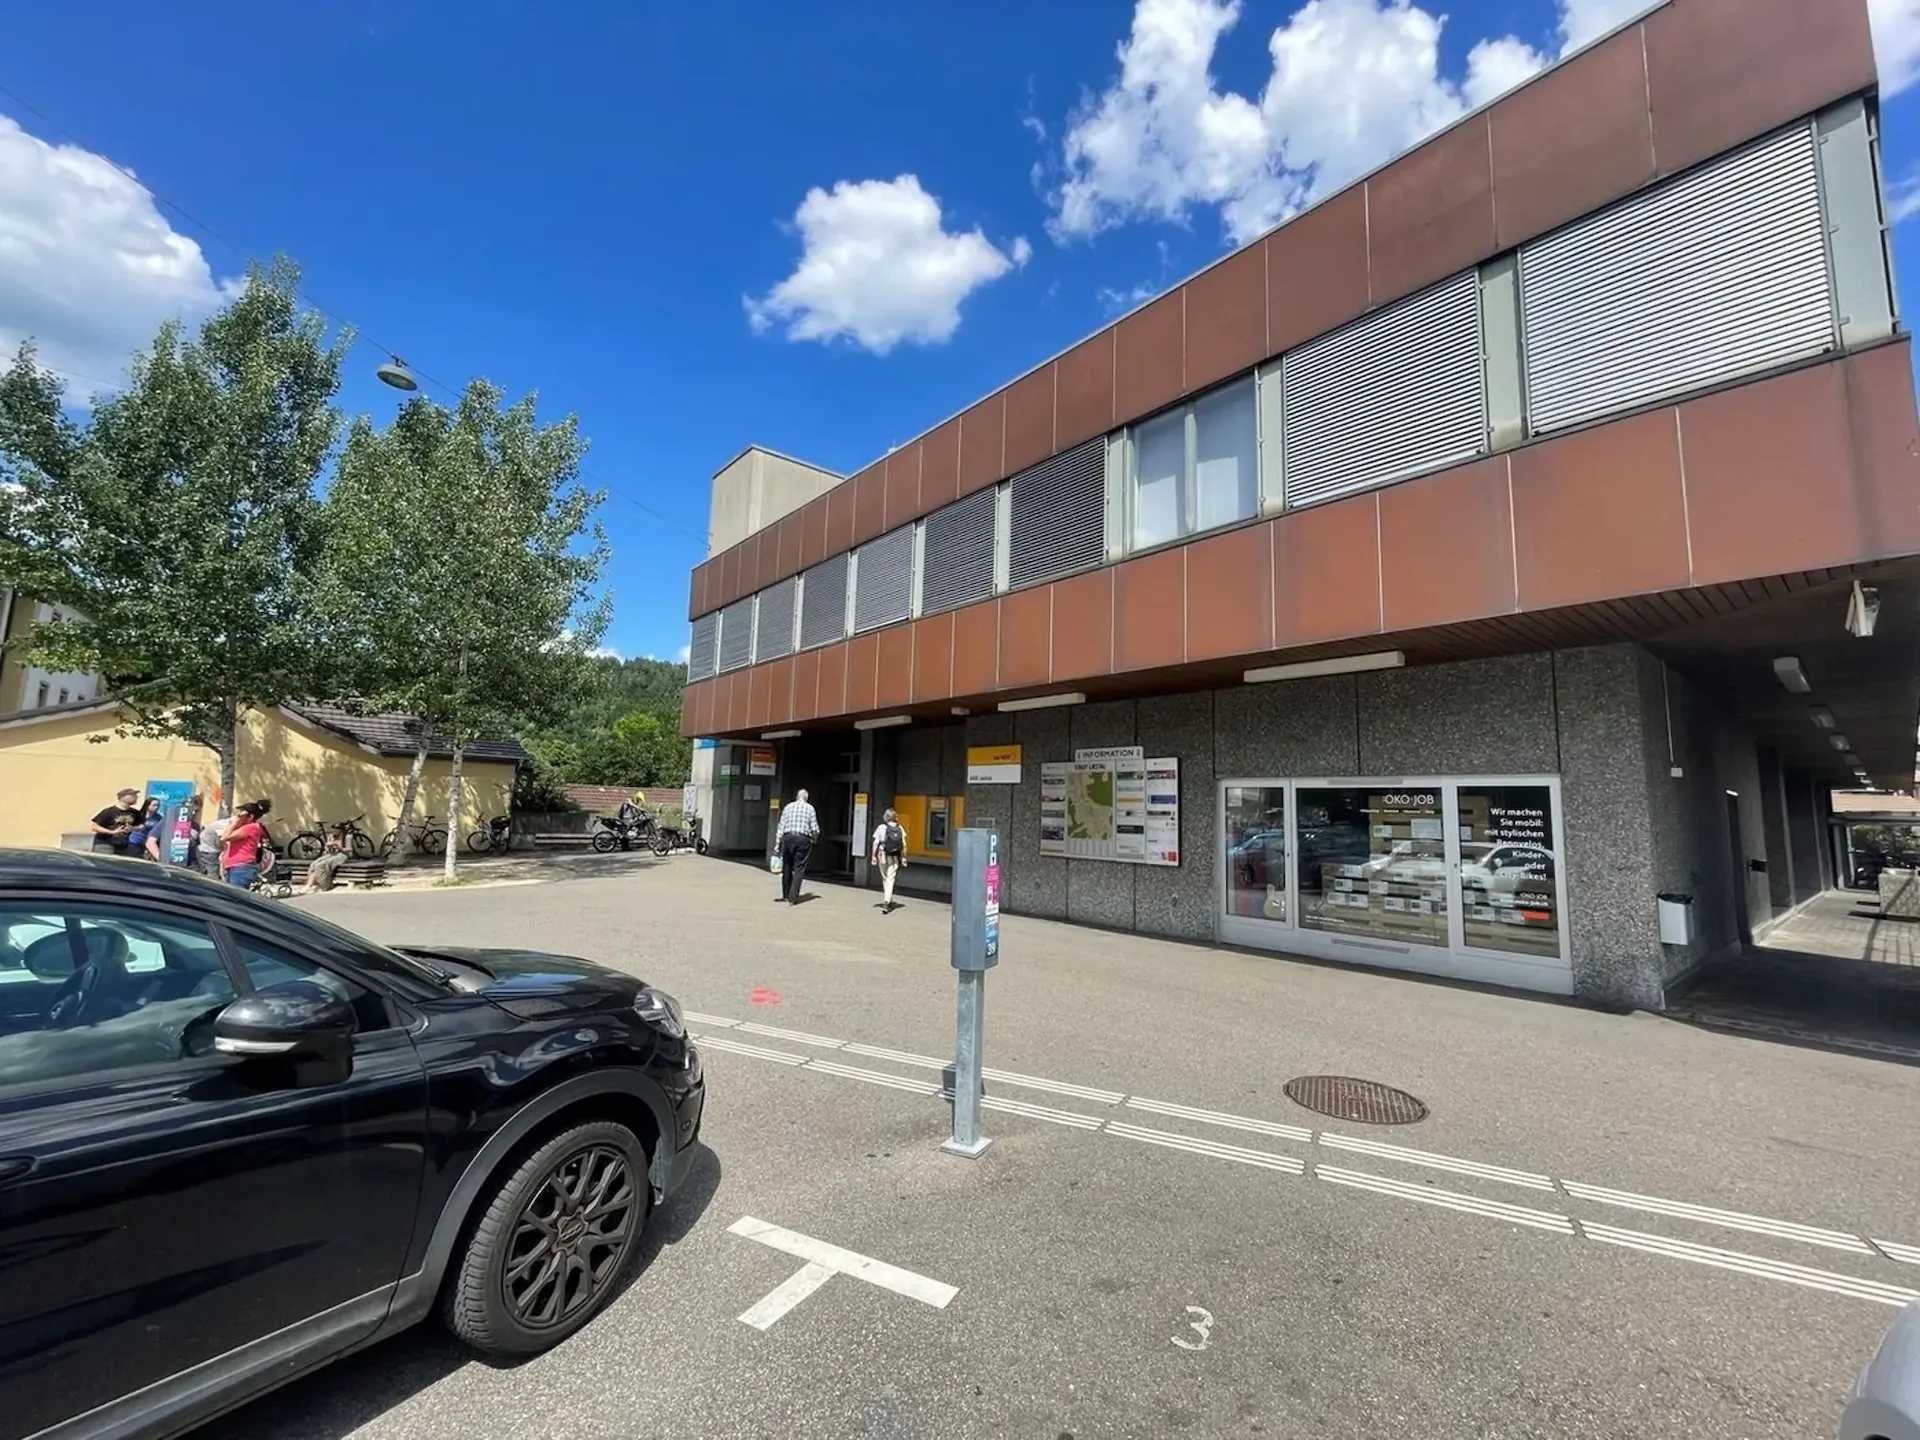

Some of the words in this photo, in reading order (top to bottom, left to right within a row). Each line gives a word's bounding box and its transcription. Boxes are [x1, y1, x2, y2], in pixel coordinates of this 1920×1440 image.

[1082, 749, 1134, 758] INFORMATION
[1490, 807, 1505, 816] Wir
[1506, 808, 1543, 816] machen
[1500, 818, 1513, 827] Sie
[1515, 819, 1544, 827] mobil:
[1500, 829, 1544, 838] stylischen
[1524, 862, 1546, 870] oder
[1170, 1305, 1214, 1351] 3
